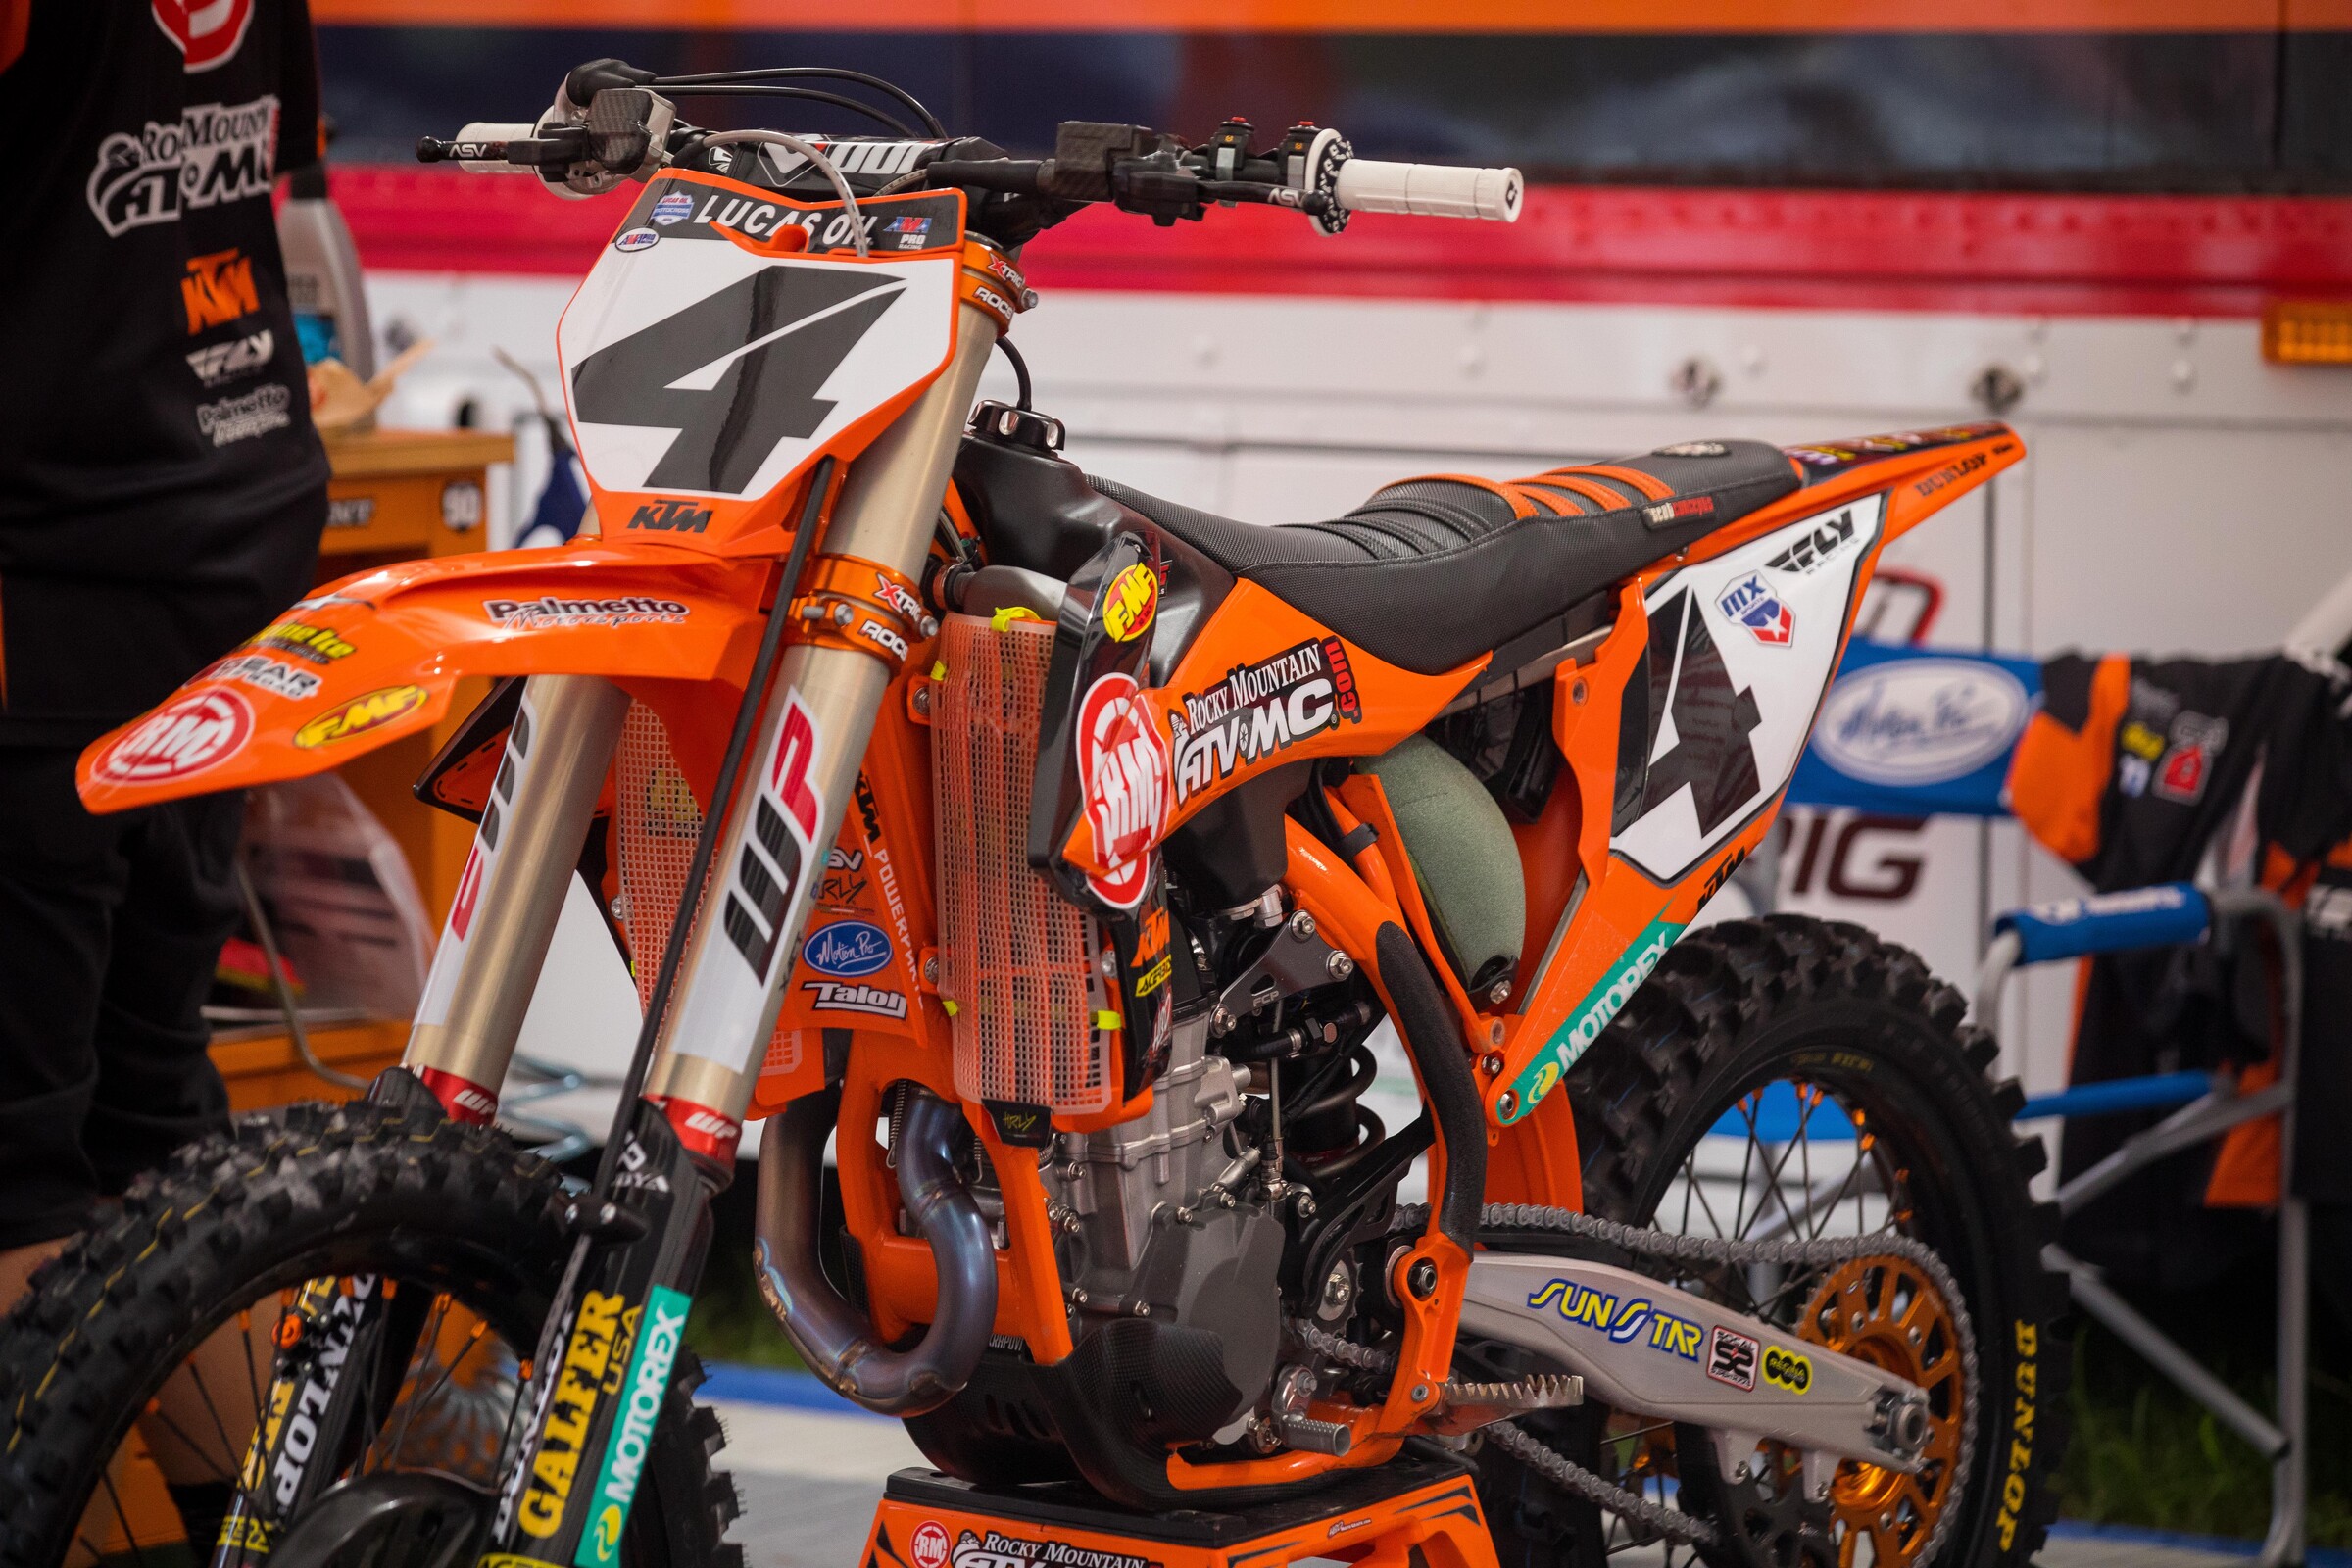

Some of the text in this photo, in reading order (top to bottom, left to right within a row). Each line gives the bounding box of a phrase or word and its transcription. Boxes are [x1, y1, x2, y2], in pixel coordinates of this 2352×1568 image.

[449, 144, 487, 158] ASV
[694, 195, 822, 237] LUCAS
[883, 216, 933, 234] AMA
[899, 234, 926, 245] PRO
[972, 286, 1014, 320] ROCS
[571, 264, 907, 496] 4
[626, 499, 714, 534] KTM
[1765, 508, 1854, 572] FLY
[487, 596, 689, 621] Palmetto
[1104, 562, 1155, 643] FMF
[1720, 574, 1766, 618] MX
[858, 618, 910, 662] ROCS
[1185, 685, 1231, 735] ROCKY
[1228, 643, 1322, 710] MOUNTAIN
[1610, 579, 1763, 840] 4
[294, 685, 421, 749] FMF
[1696, 847, 1745, 912] KTM
[816, 930, 882, 967] Motion Pro
[1130, 906, 1171, 968] KTM
[802, 982, 908, 1019] Talon
[1252, 990, 1279, 1007] FCP
[1555, 931, 1669, 1072] MOTOREX
[602, 1303, 644, 1396] USA
[517, 1289, 626, 1540] GALFER
[604, 1300, 686, 1504] MOTOREX
[1996, 1318, 2038, 1553] DUNLOP
[982, 1532, 1042, 1558] ROCKY
[1043, 1543, 1146, 1568] MOUNTAIN
